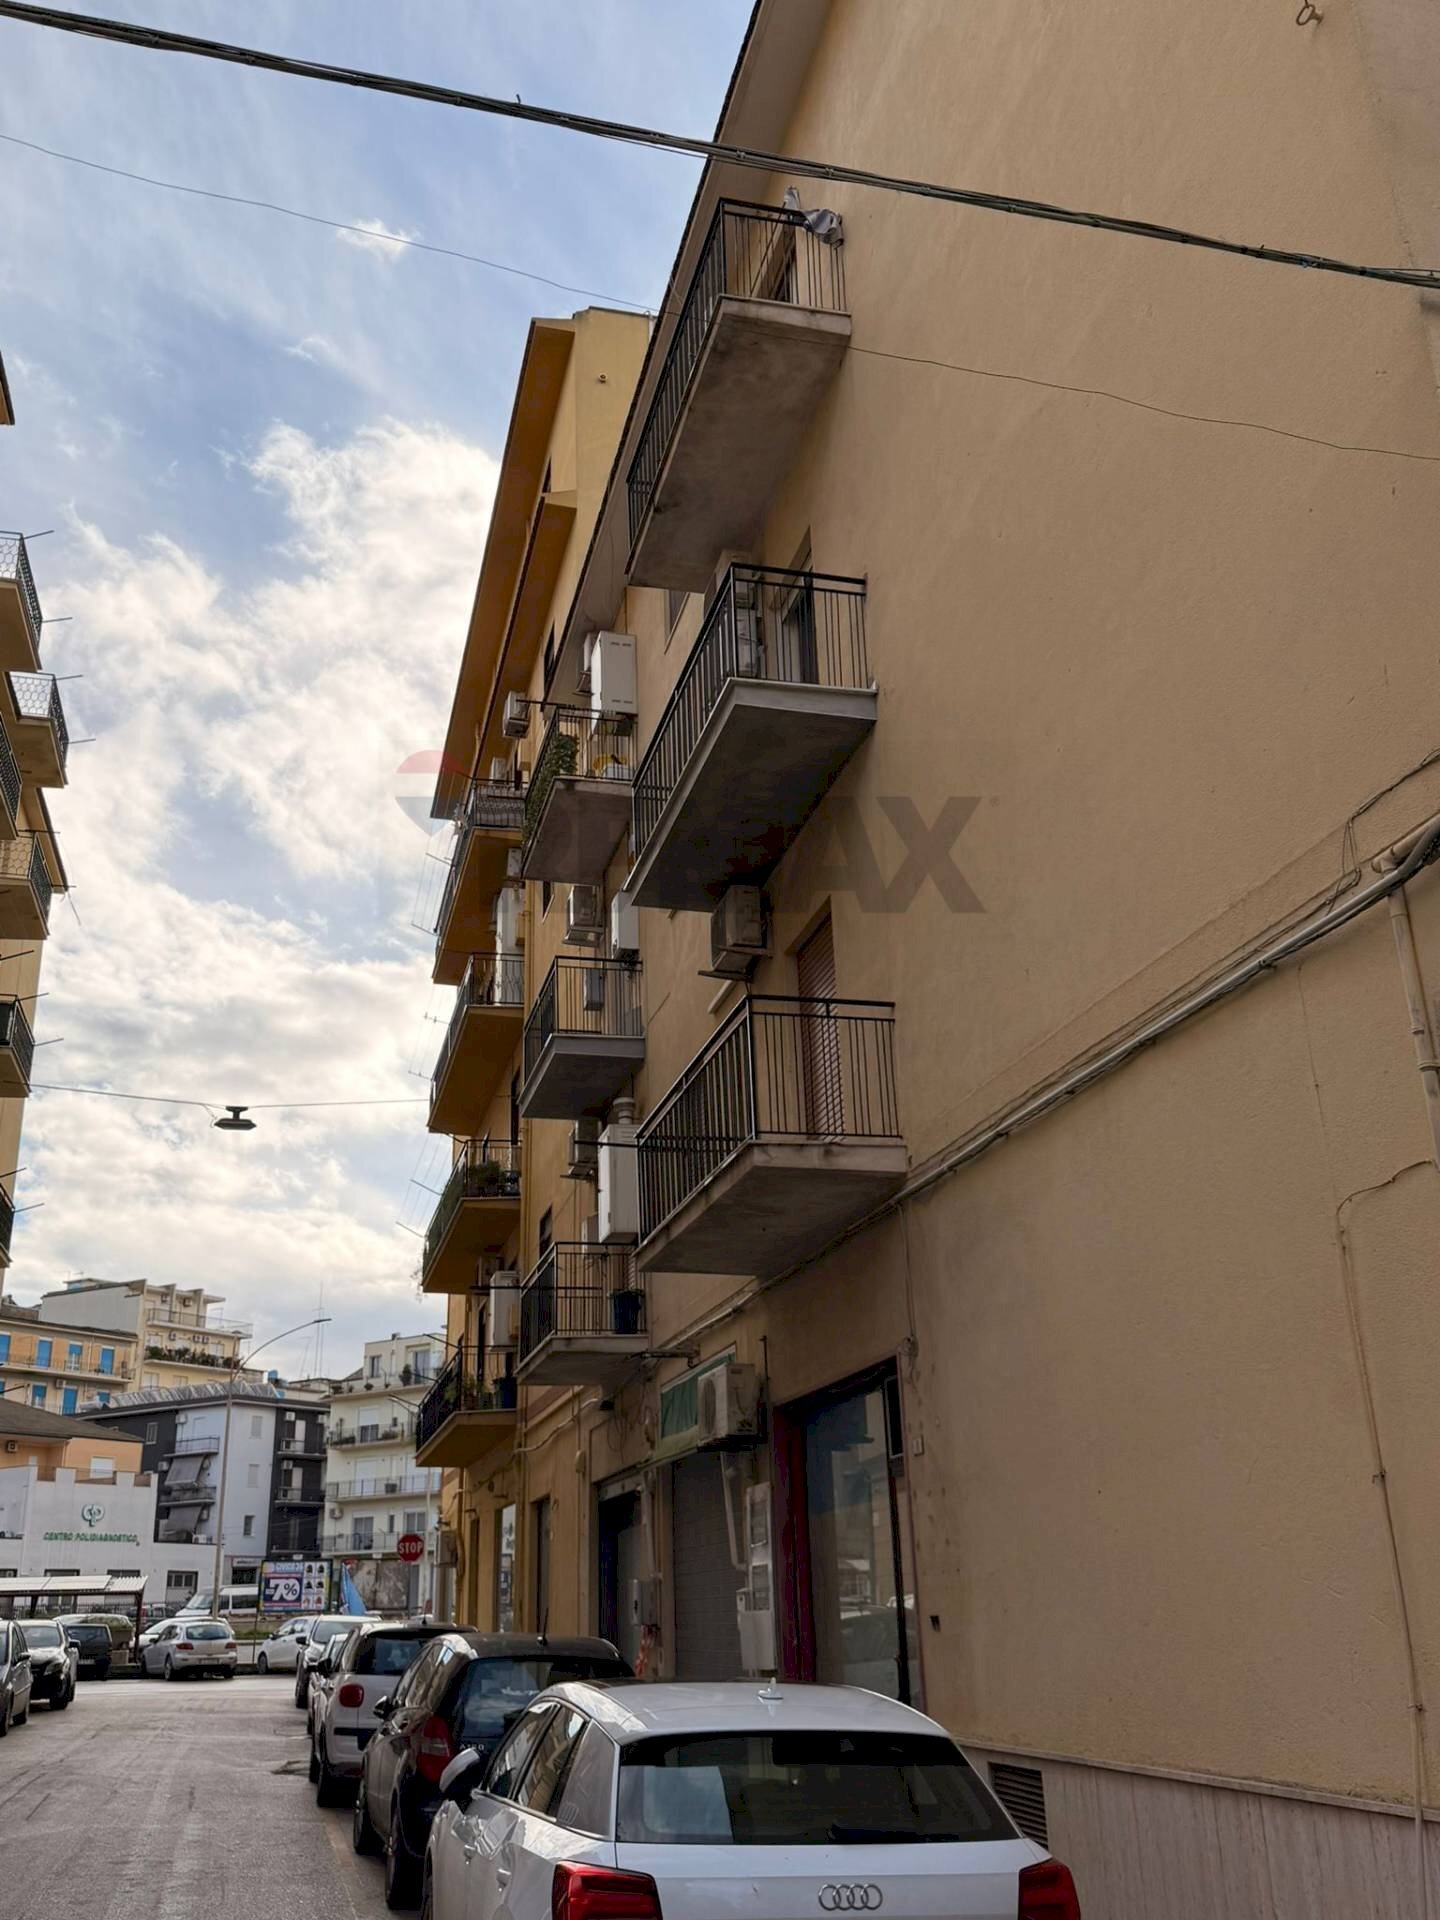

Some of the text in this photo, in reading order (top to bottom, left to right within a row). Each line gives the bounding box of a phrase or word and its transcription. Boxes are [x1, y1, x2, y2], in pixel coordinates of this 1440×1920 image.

[43, 1532, 137, 1543] CENTRO POLIDIAGNOSTICO
[399, 1541, 423, 1554] STOP
